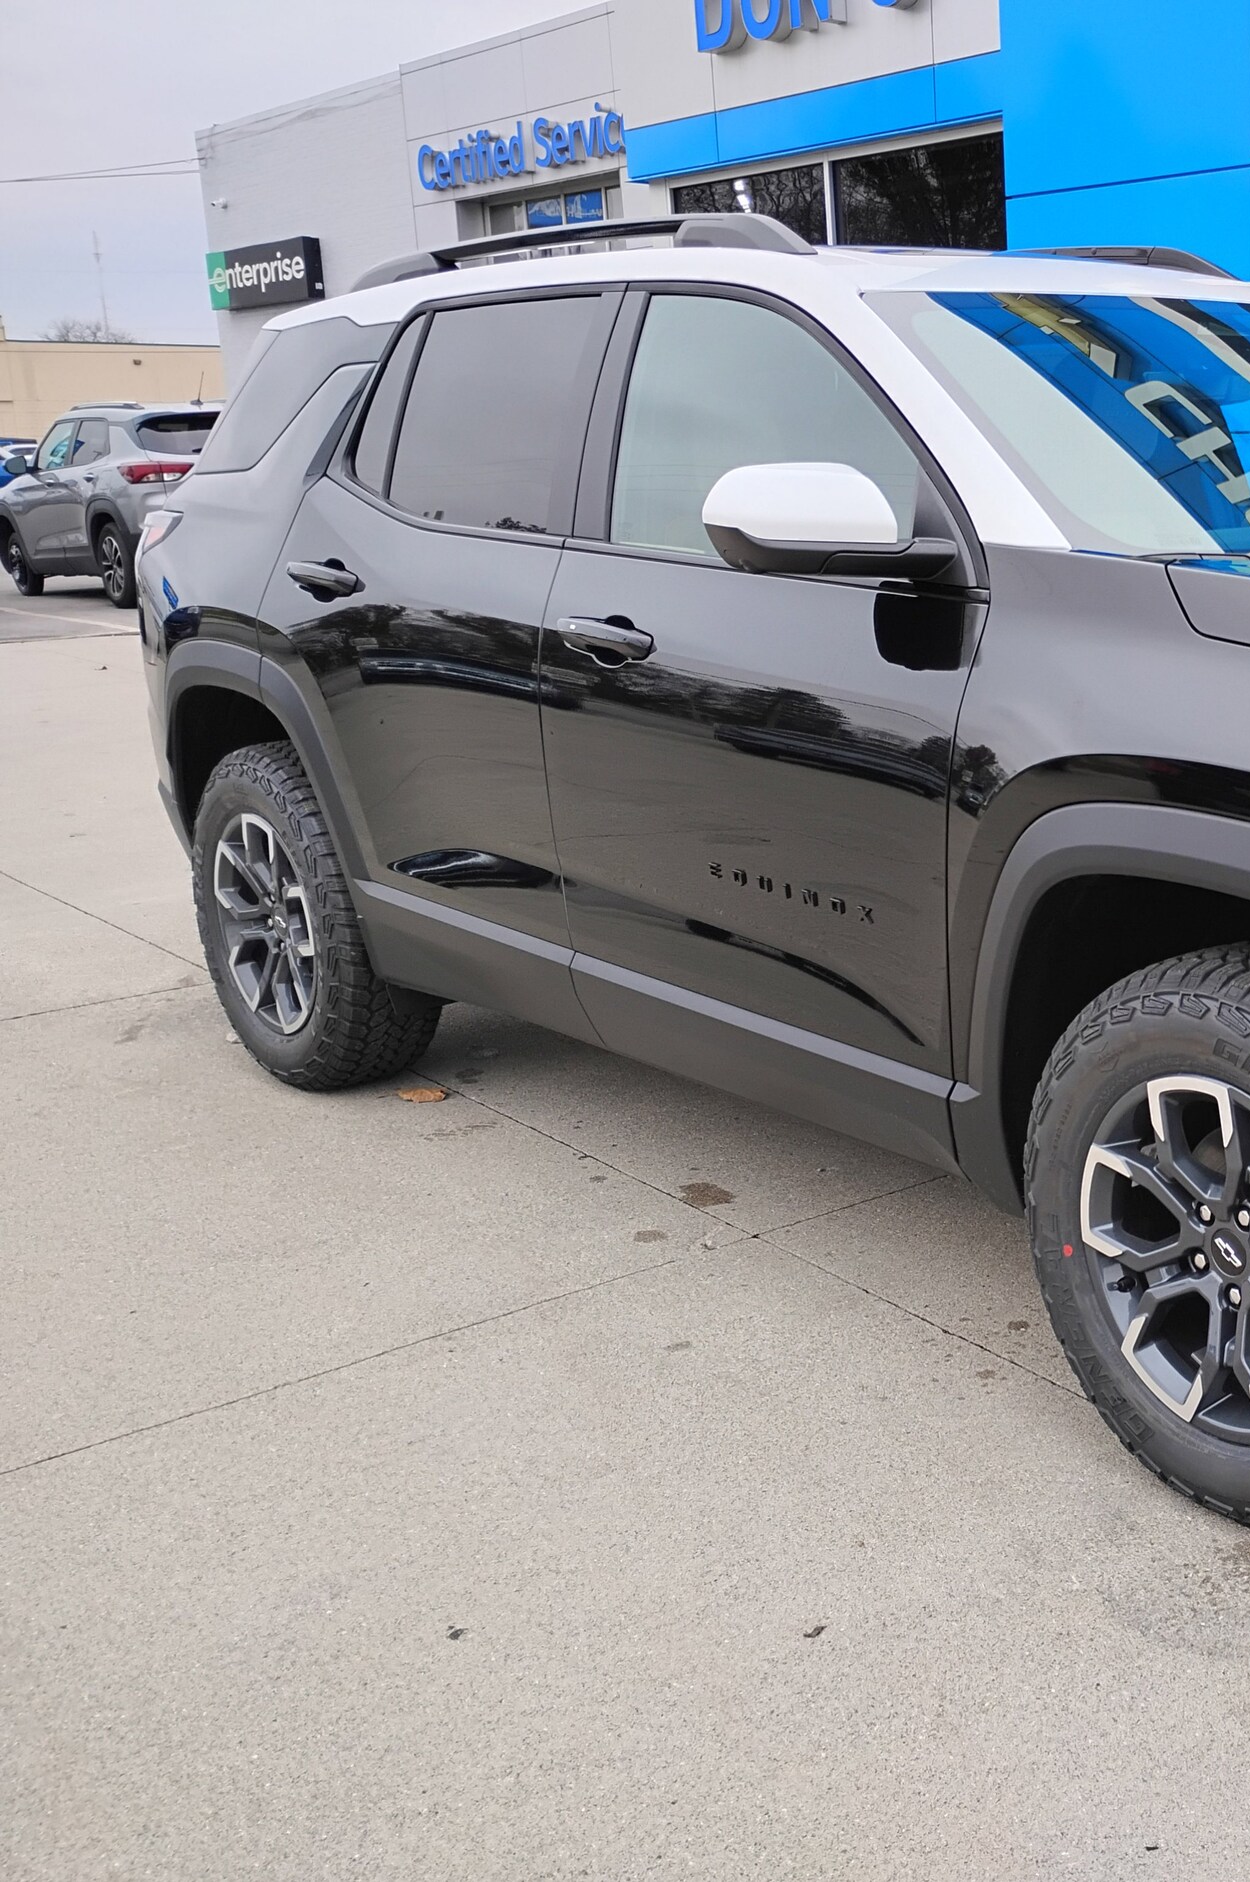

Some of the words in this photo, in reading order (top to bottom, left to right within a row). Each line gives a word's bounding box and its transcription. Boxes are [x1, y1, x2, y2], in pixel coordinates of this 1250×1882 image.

[418, 121, 525, 191] Certified
[533, 102, 626, 168] Servic
[209, 251, 304, 292] enterprise
[708, 861, 874, 924] EQUINOX
[1043, 1211, 1153, 1446] GENERAL
